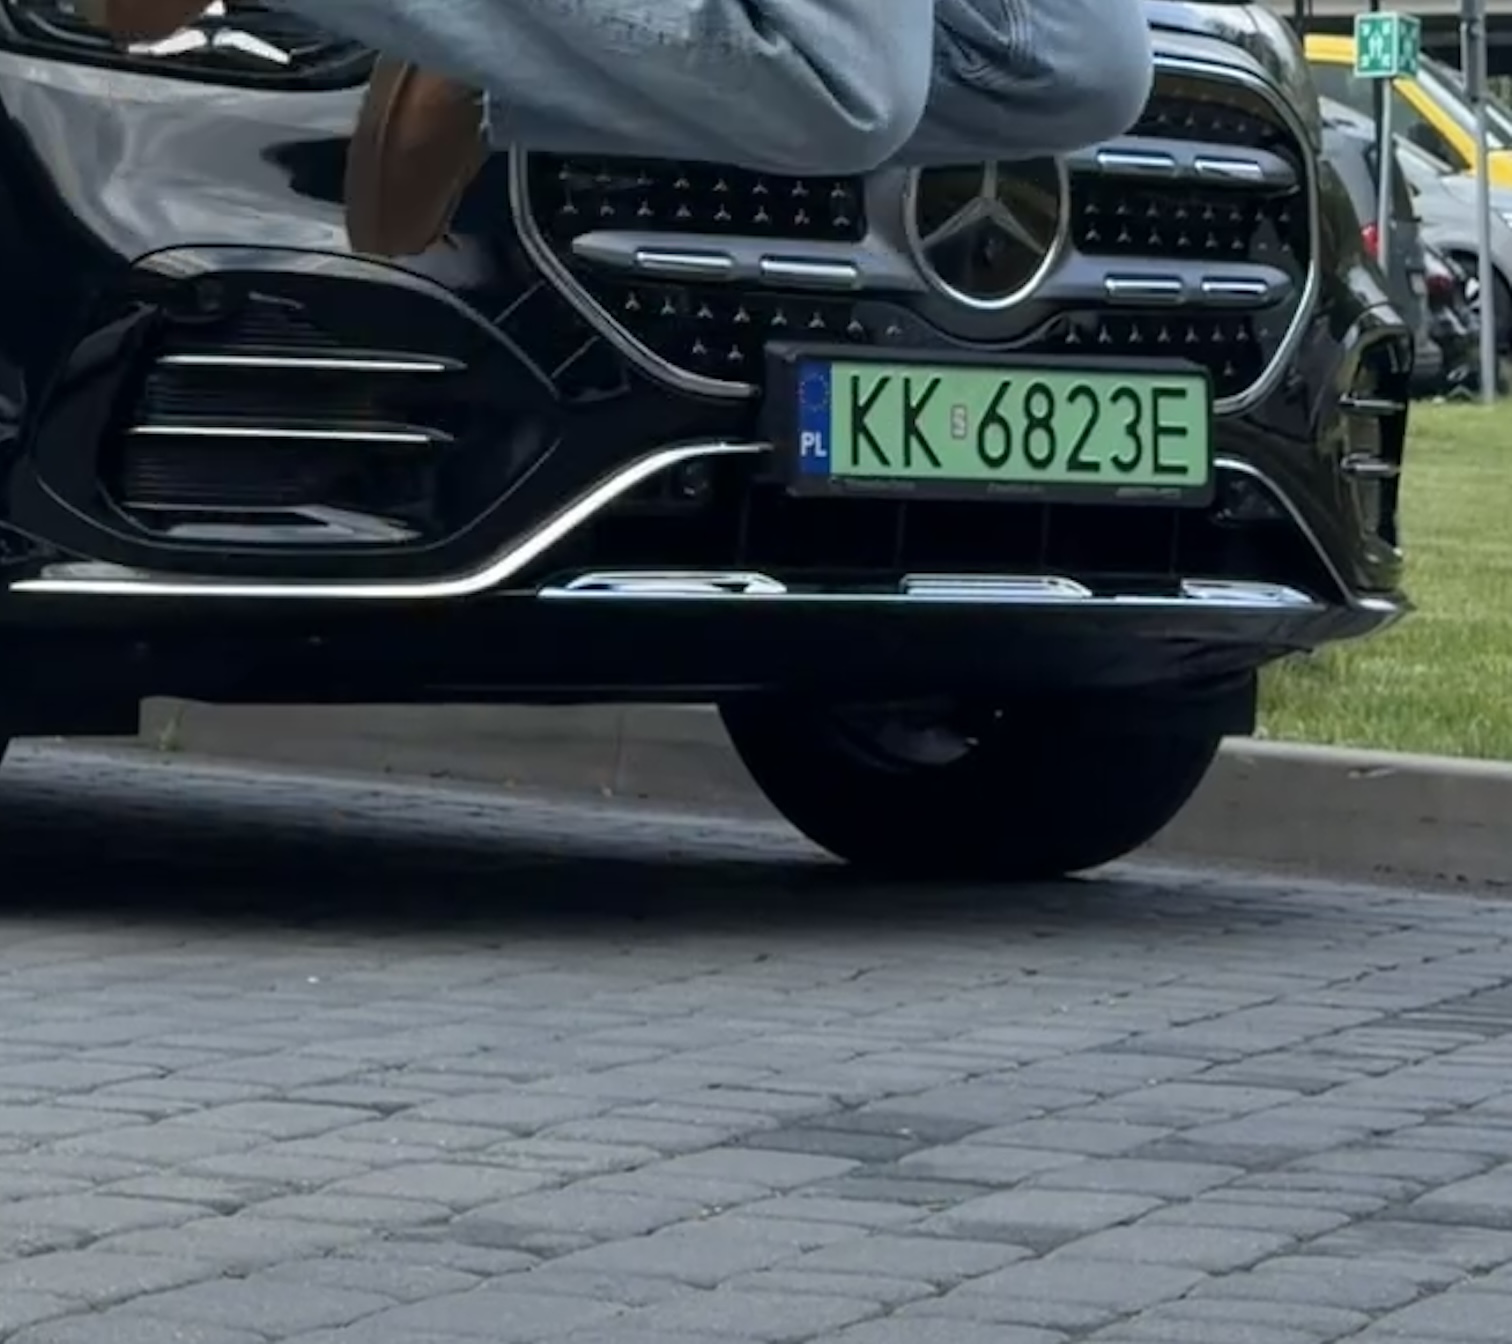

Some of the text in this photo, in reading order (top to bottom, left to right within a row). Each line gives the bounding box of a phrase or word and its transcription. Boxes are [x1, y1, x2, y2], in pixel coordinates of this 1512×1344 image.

[800, 432, 828, 458] PL
[850, 375, 1189, 475] KK 6823E
